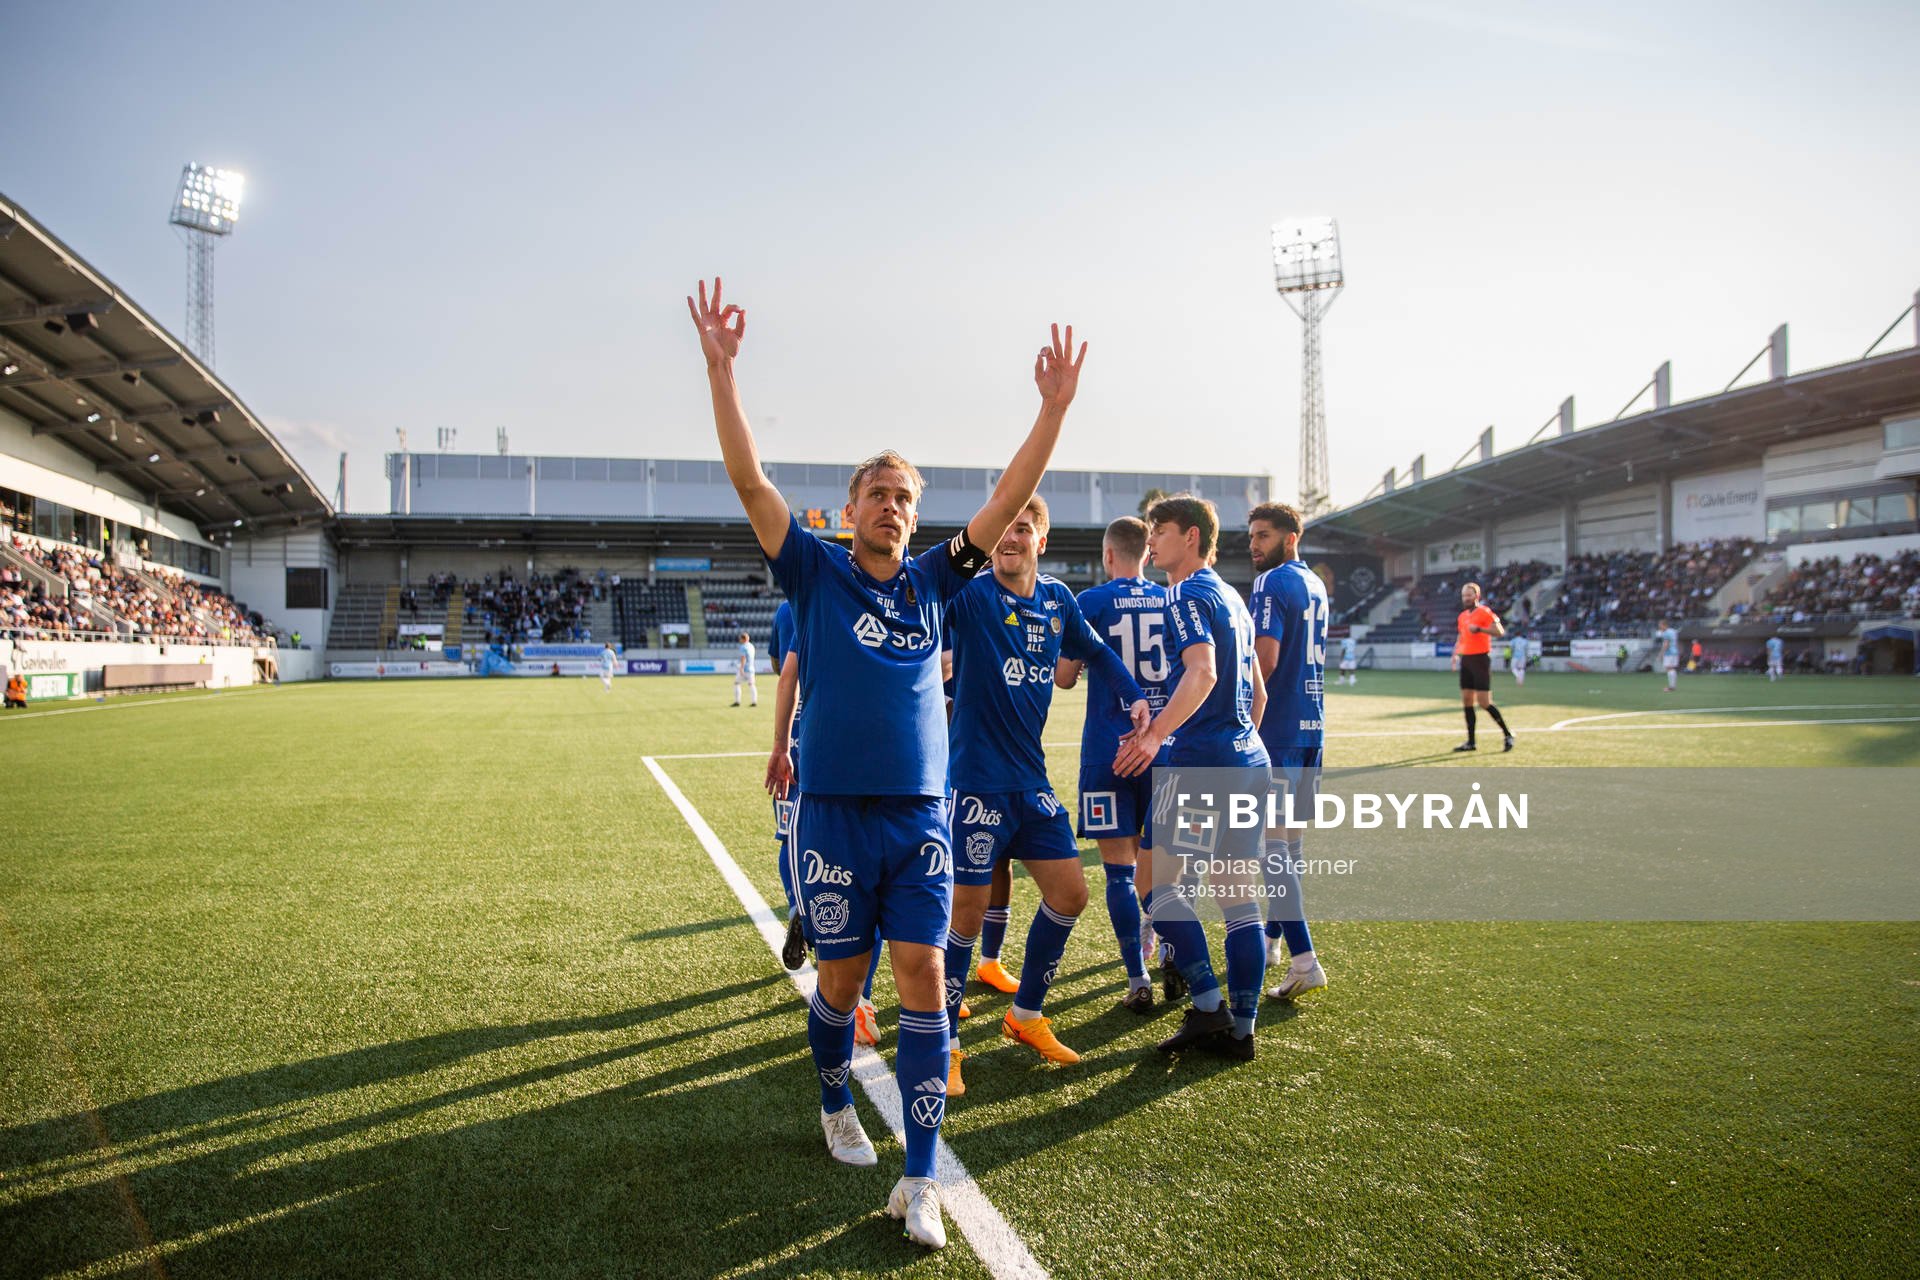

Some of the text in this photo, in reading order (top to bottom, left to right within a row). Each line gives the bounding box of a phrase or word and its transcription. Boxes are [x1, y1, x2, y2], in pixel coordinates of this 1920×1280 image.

[1113, 597, 1164, 609] LUNDSTRÖM
[1188, 600, 1205, 636] stadium
[1262, 596, 1272, 630] stadium
[1170, 604, 1188, 642] stadium
[1303, 600, 1329, 665] 13
[892, 632, 932, 650] SCA
[1108, 613, 1168, 682] 15
[1028, 666, 1055, 684] SCA
[961, 796, 1002, 826] Diös
[803, 850, 853, 886] Diös
[816, 905, 842, 921] HSB
